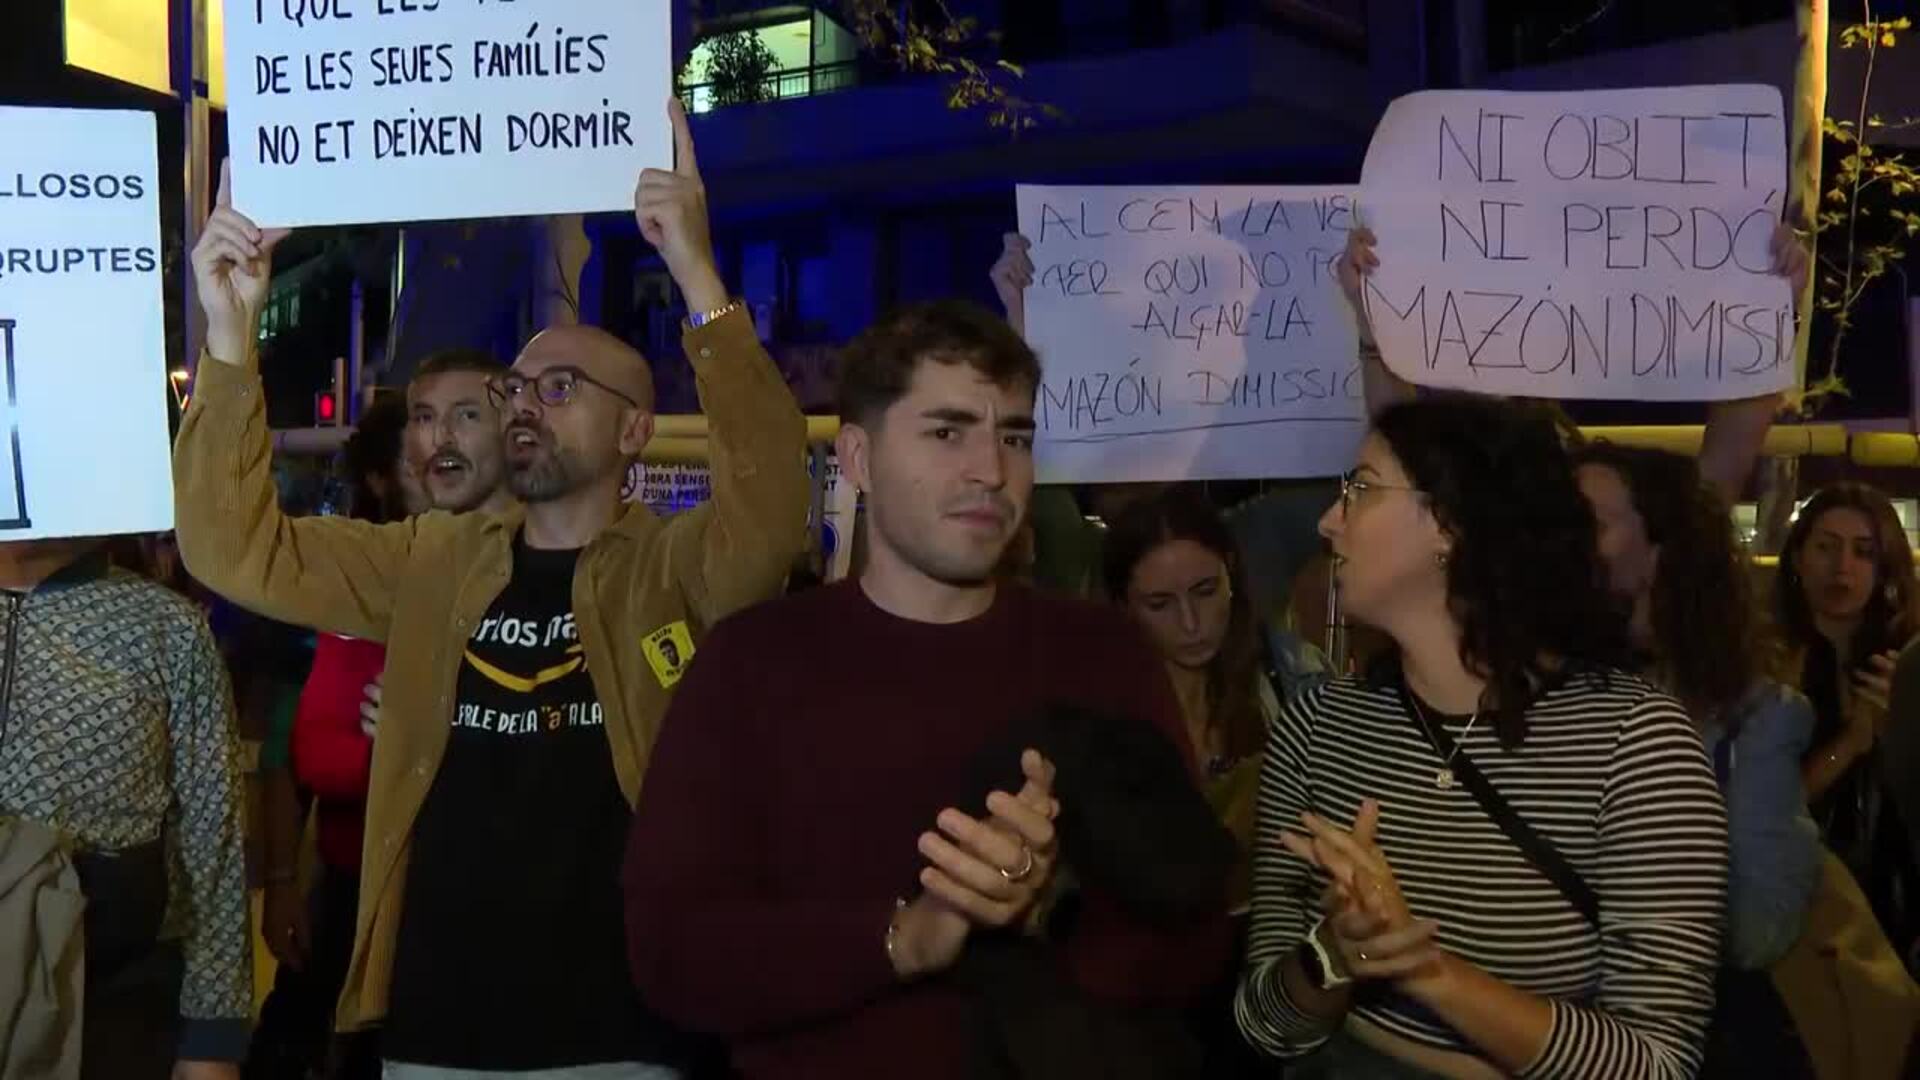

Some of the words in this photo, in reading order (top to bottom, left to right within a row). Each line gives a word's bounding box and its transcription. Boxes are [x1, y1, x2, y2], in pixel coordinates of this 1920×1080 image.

[256, 55, 291, 95] DE
[305, 50, 354, 91] LES
[370, 44, 453, 86] SEUES
[474, 22, 609, 78] FAMÍLIES
[258, 124, 300, 165] NO
[315, 120, 355, 163] ET
[374, 107, 482, 159] DEIXEN
[507, 98, 634, 152] DORMIR
[1439, 108, 1524, 183] NI
[1544, 113, 1776, 188] OBLIT
[1241, 197, 1292, 237] LA
[1441, 200, 1529, 262] NI
[1563, 189, 1776, 275] PERDÓ
[0, 247, 156, 278] RUPTES
[1042, 256, 1121, 297] PER
[1144, 254, 1208, 297] QUI
[1239, 250, 1290, 289] NO
[1364, 277, 1608, 379] MAZÓN
[1042, 357, 1162, 430] MAZÓN
[471, 610, 538, 647] rlos
